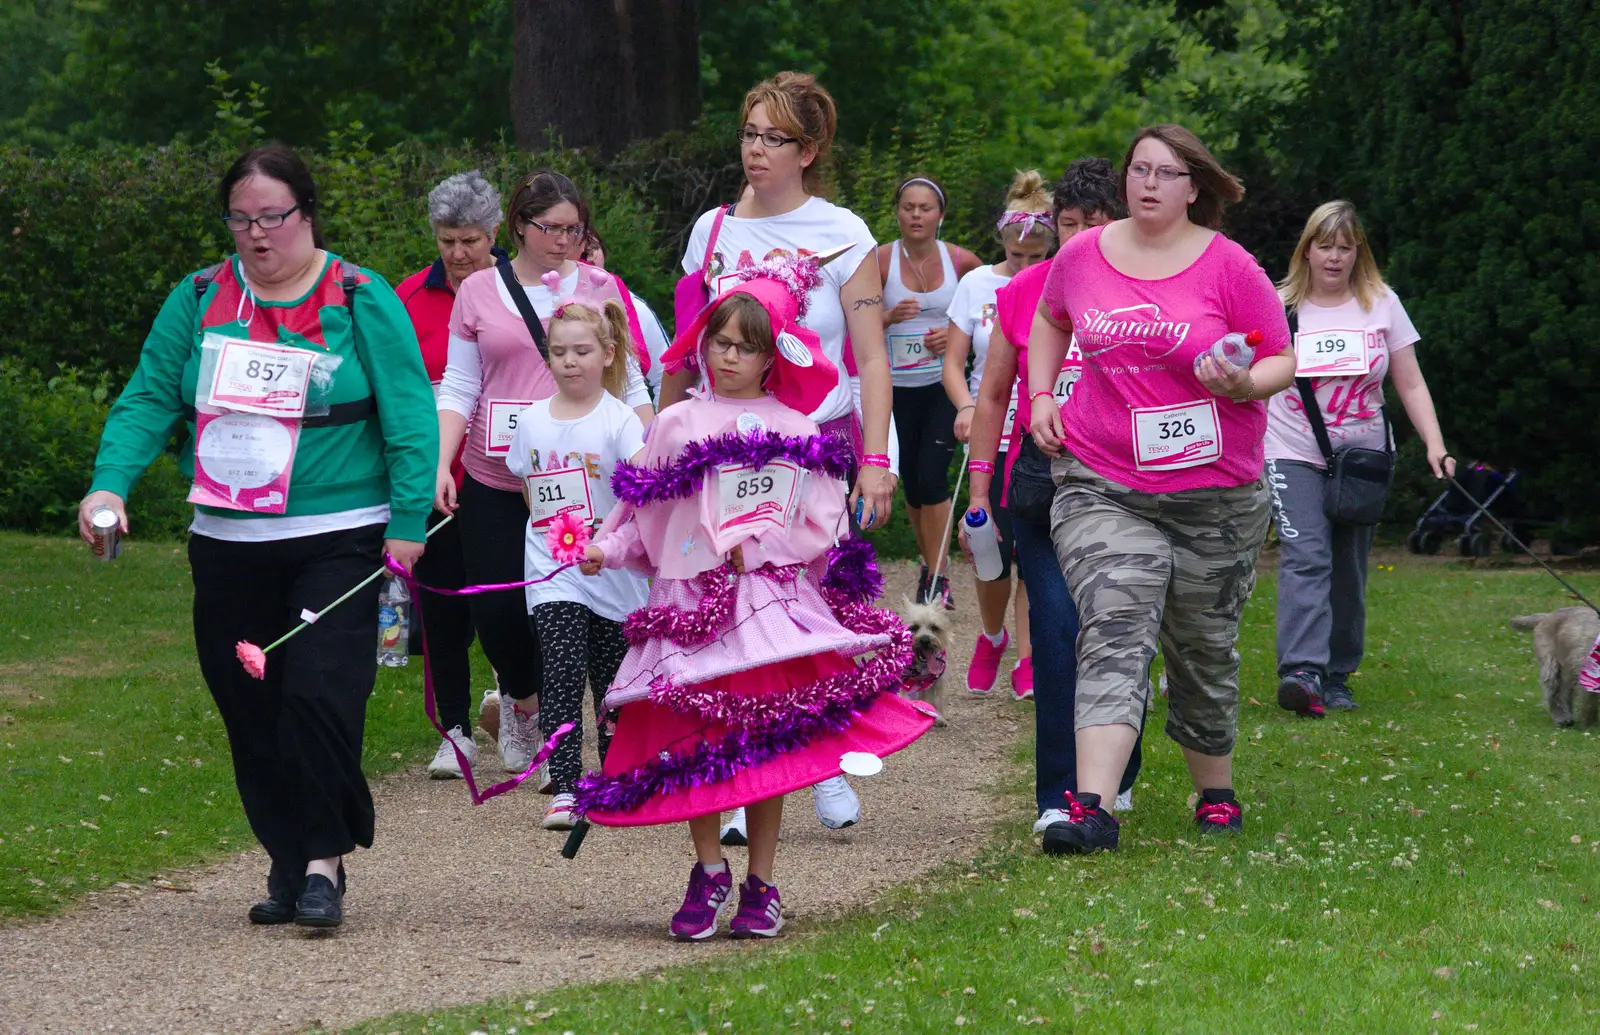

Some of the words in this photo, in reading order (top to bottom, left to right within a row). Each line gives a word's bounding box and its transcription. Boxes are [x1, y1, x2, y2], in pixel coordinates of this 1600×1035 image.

[1077, 308, 1191, 342] Slimming
[906, 343, 922, 354] 70
[1316, 339, 1346, 353] 199
[246, 359, 288, 382] 857
[1111, 365, 1140, 375] you're
[1056, 381, 1074, 397] 10
[508, 414, 518, 430] 5
[1158, 418, 1196, 440] 326
[1148, 445, 1170, 454] TESCO
[530, 448, 600, 480] RACE
[538, 484, 565, 503] 511
[736, 476, 774, 499] 859
